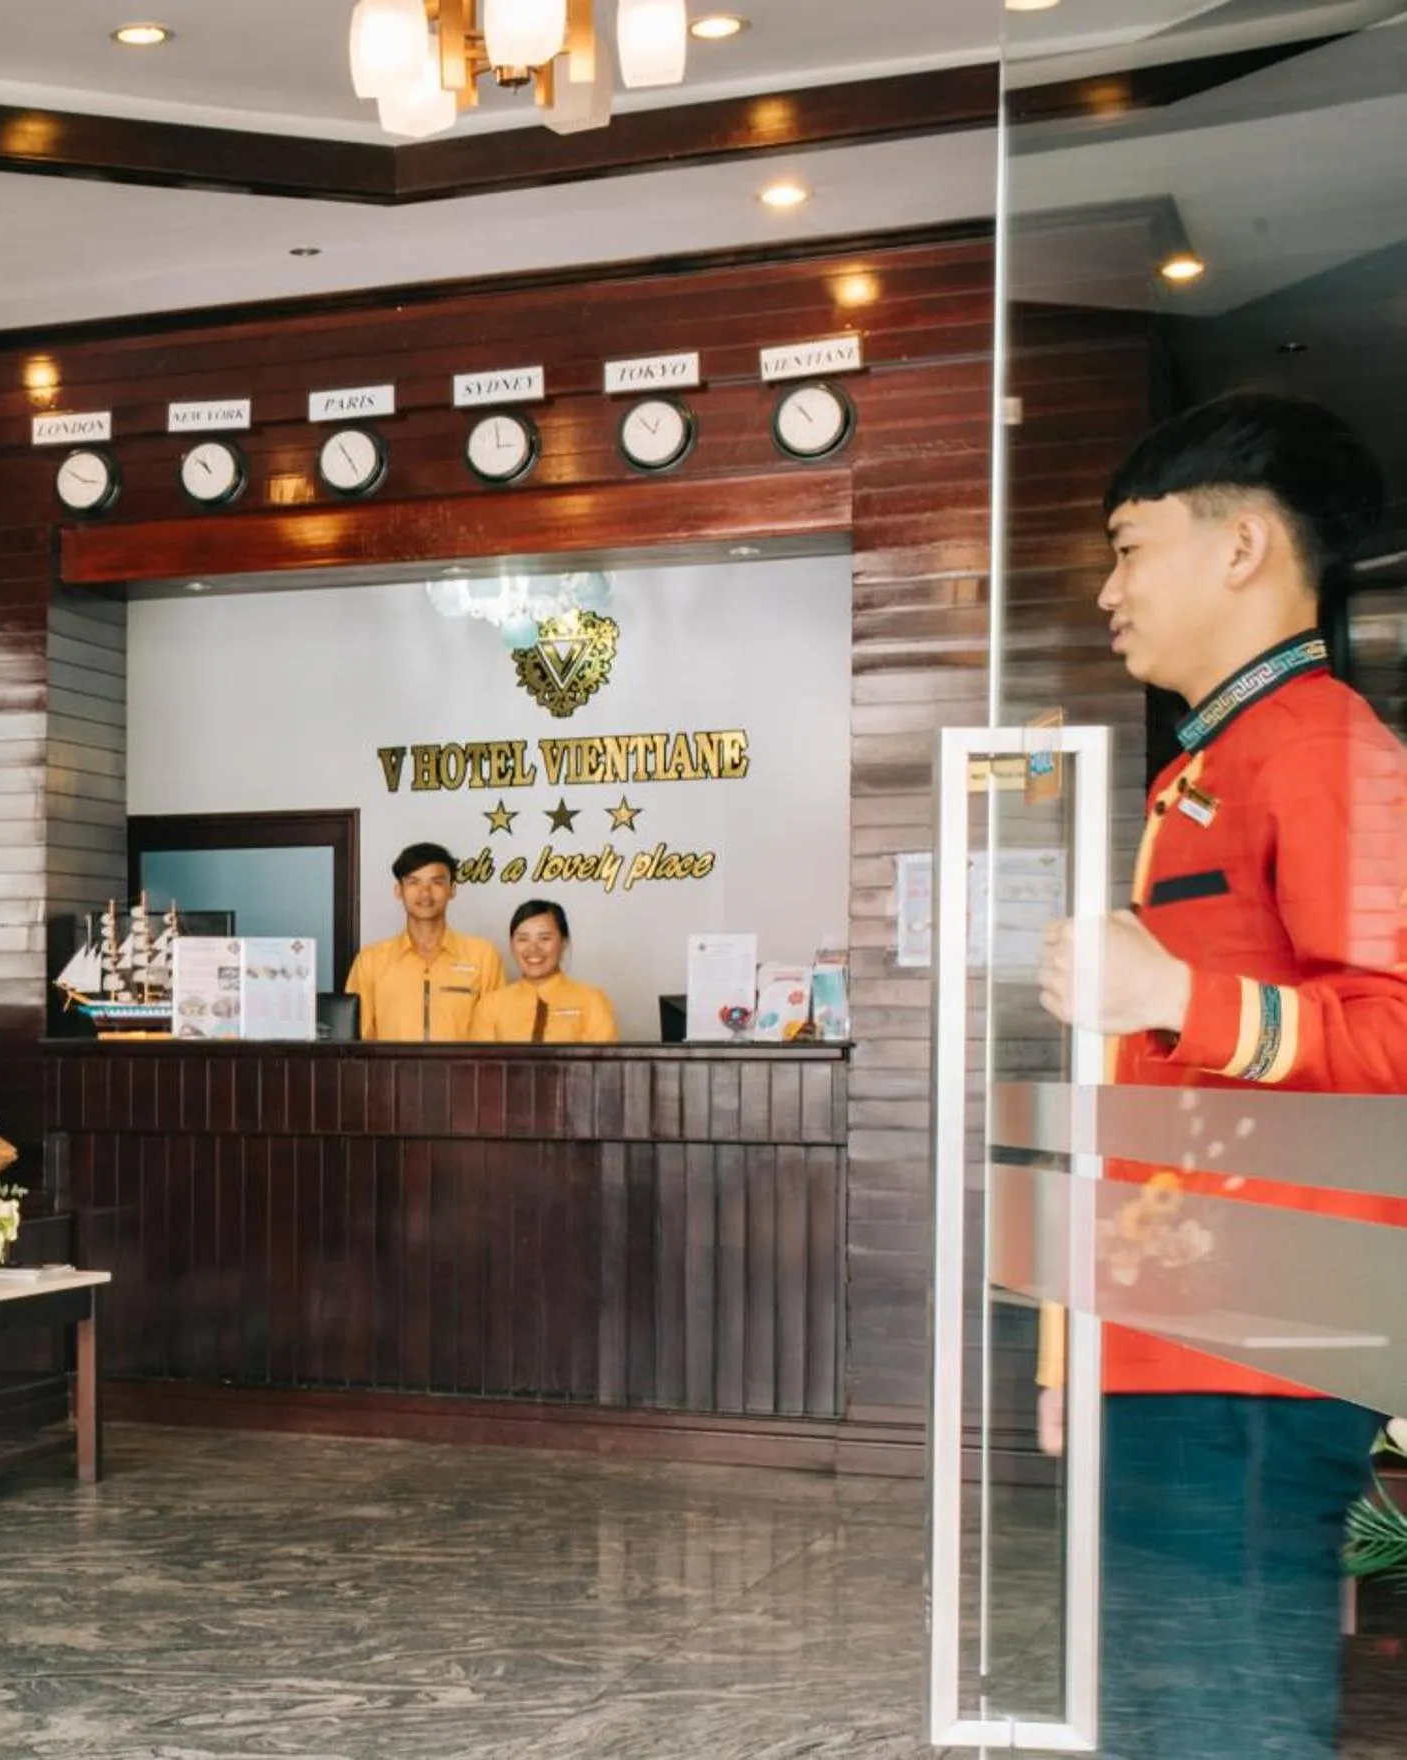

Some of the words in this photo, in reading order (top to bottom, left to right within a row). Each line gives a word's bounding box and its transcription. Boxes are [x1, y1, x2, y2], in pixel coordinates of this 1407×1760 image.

[617, 361, 688, 382] TOKYO
[463, 375, 538, 396] SYDNEY
[323, 393, 376, 412] PARIS
[173, 409, 202, 422] NEW
[204, 406, 244, 421] YORK
[36, 418, 107, 437] LONDON
[377, 746, 407, 792] V
[410, 740, 537, 791] HOTEL
[539, 729, 750, 785] VIENTIANE
[455, 847, 494, 884] ch
[500, 856, 527, 883] a
[532, 843, 624, 893] lovely
[623, 842, 715, 891] place
